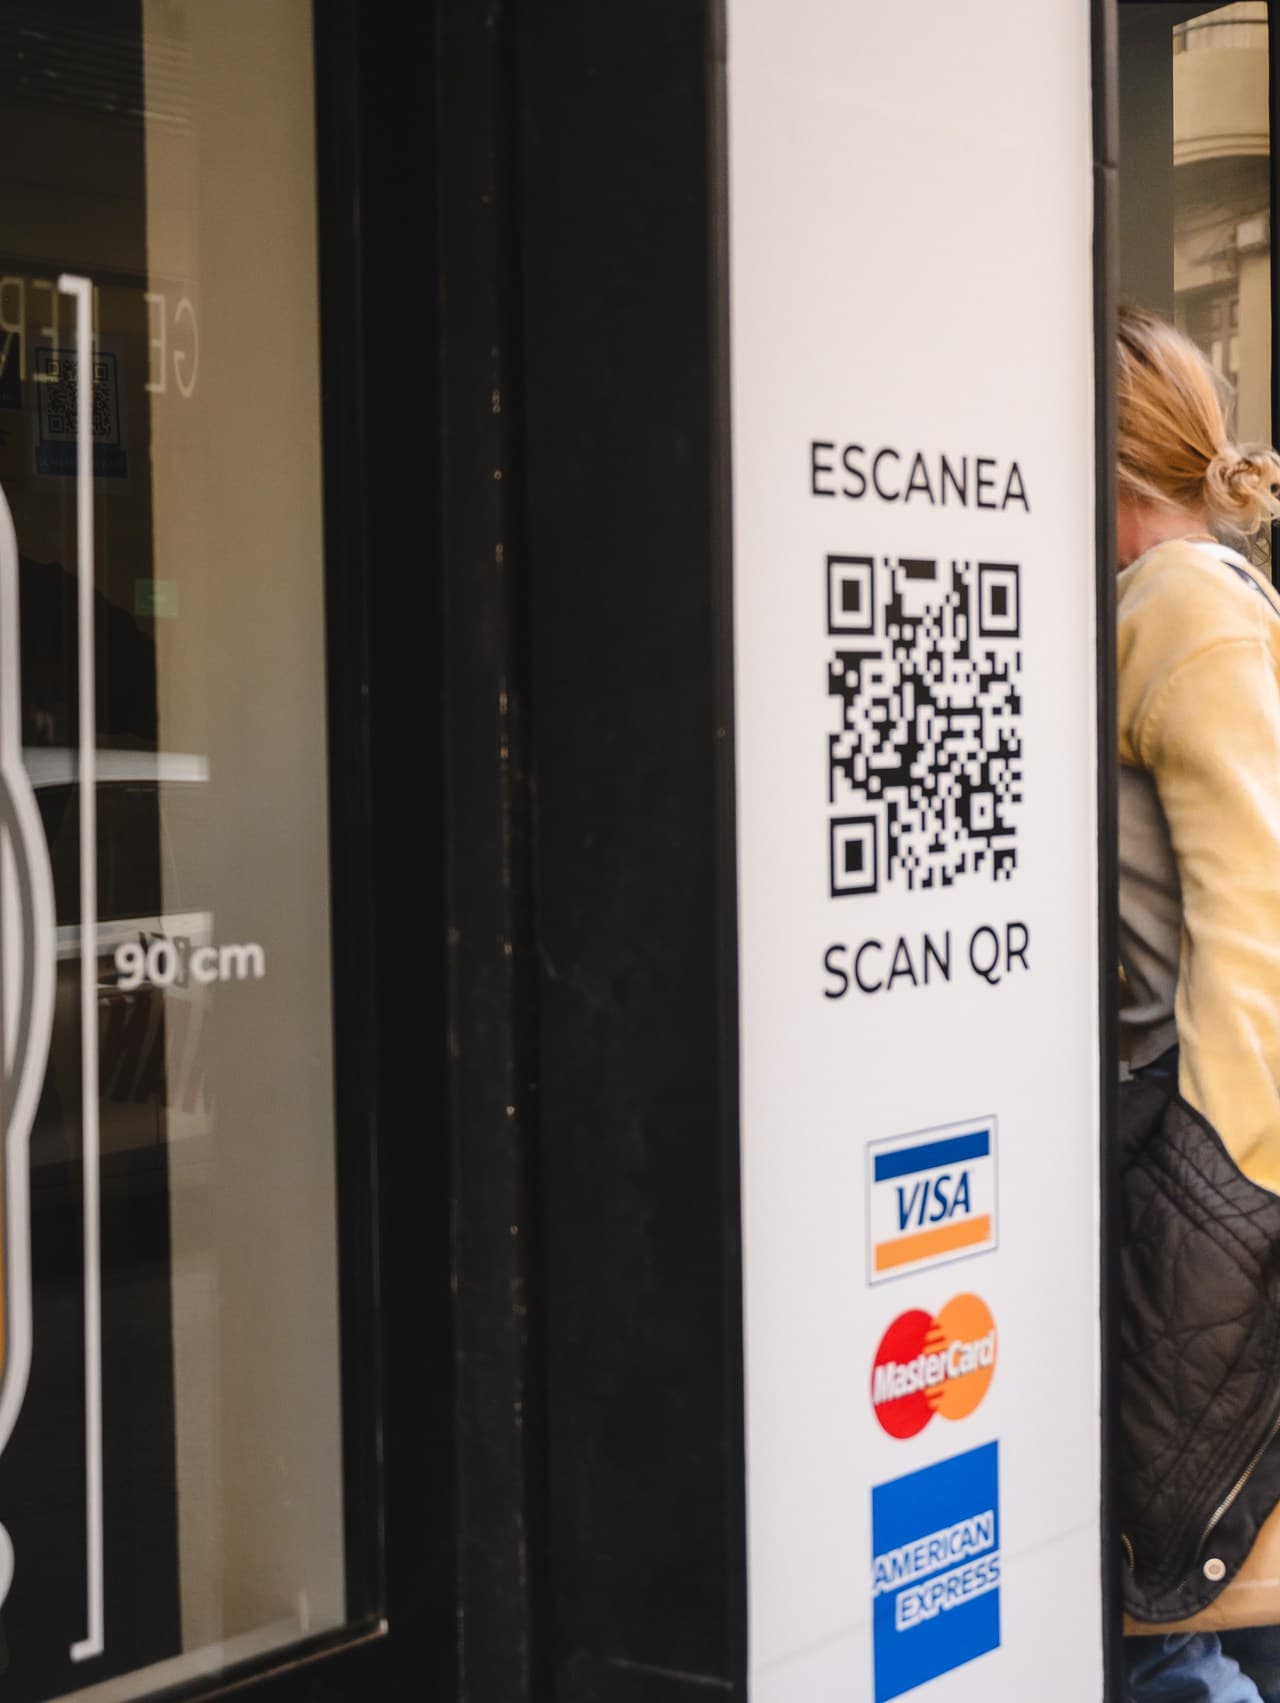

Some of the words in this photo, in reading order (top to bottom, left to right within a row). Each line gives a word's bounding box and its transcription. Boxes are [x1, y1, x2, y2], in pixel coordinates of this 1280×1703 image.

[809, 441, 1031, 513] ESCANEA
[114, 941, 178, 991] 90
[189, 941, 266, 983] cm
[823, 930, 952, 999] SCAN
[968, 921, 1031, 986] QR
[895, 1170, 972, 1231] VISA
[873, 1330, 996, 1406] MasterCard
[873, 1513, 995, 1593] AMERICAN
[898, 1559, 1001, 1627] EXPRESS
